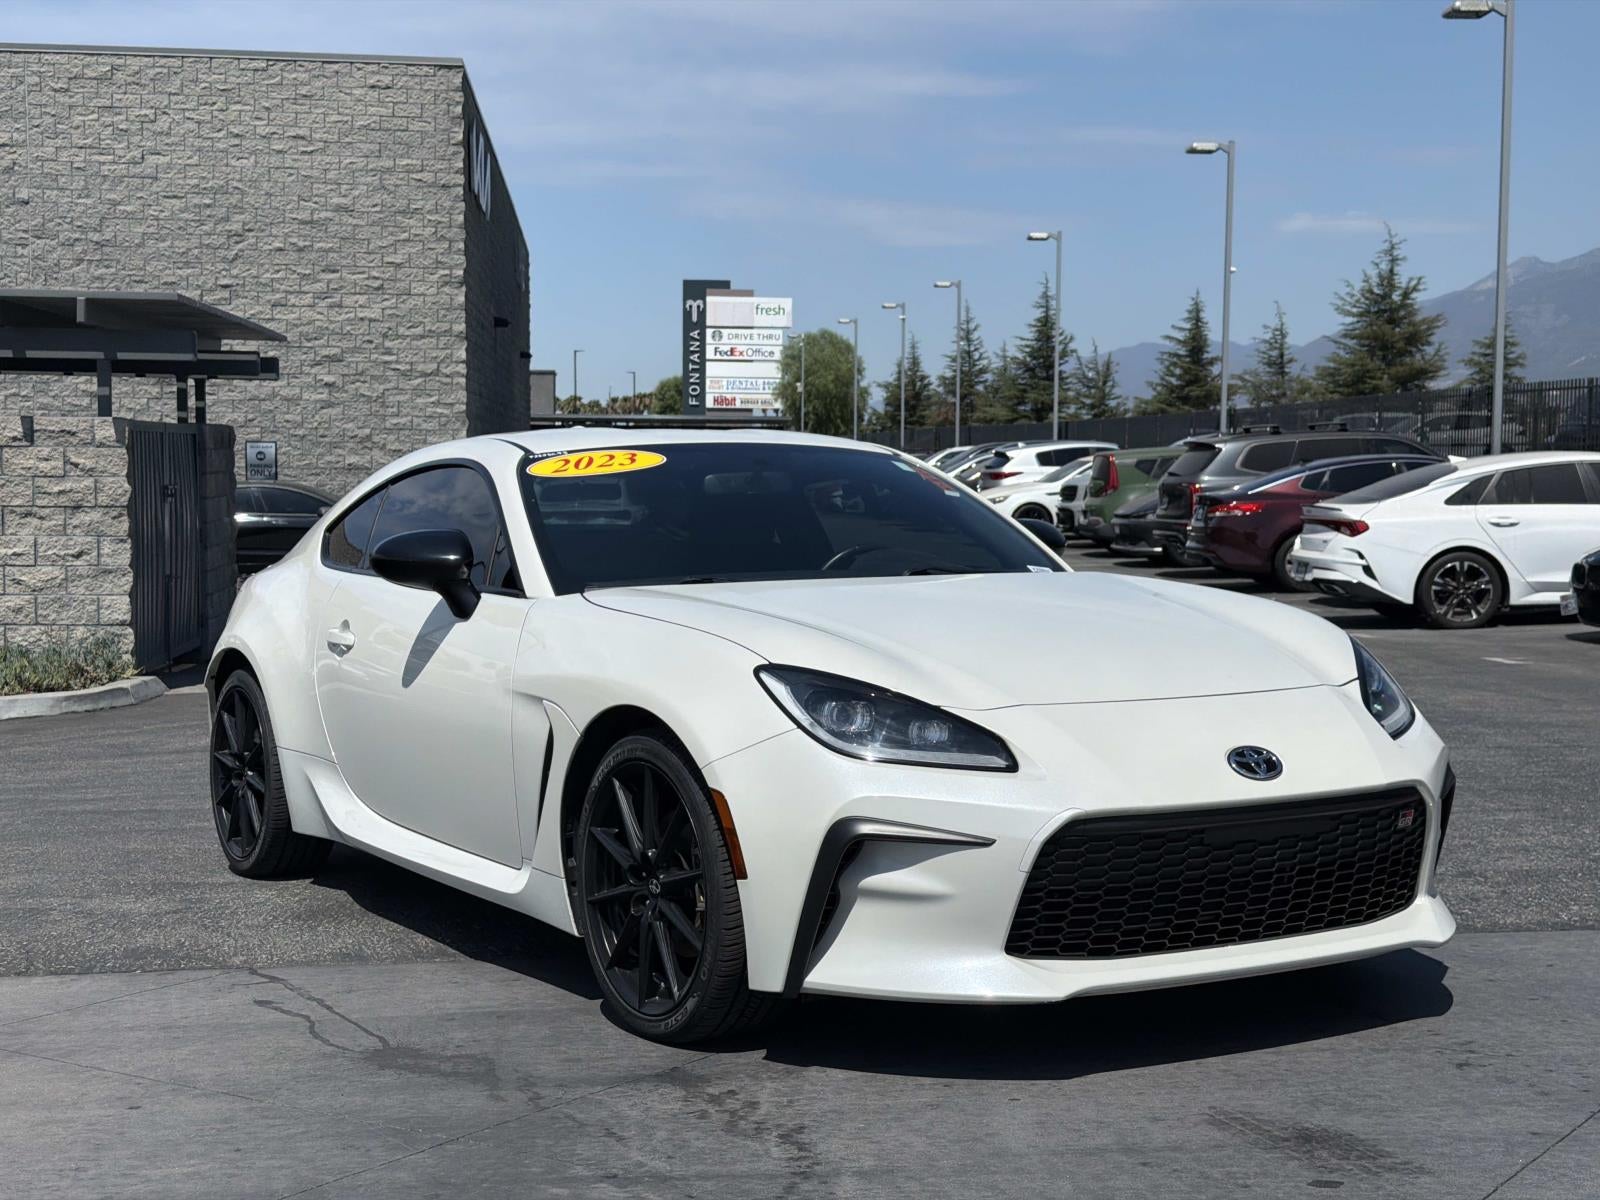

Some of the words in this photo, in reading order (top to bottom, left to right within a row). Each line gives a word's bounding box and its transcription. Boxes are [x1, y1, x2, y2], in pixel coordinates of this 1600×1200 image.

[755, 304, 785, 316] fresh
[727, 333, 755, 341] DRIVE
[758, 333, 780, 341] THRU
[714, 346, 745, 357] FedEx
[745, 347, 775, 358] Office
[689, 329, 701, 406] FONTANA
[551, 452, 638, 473] 2023
[250, 469, 273, 477] ONLY
